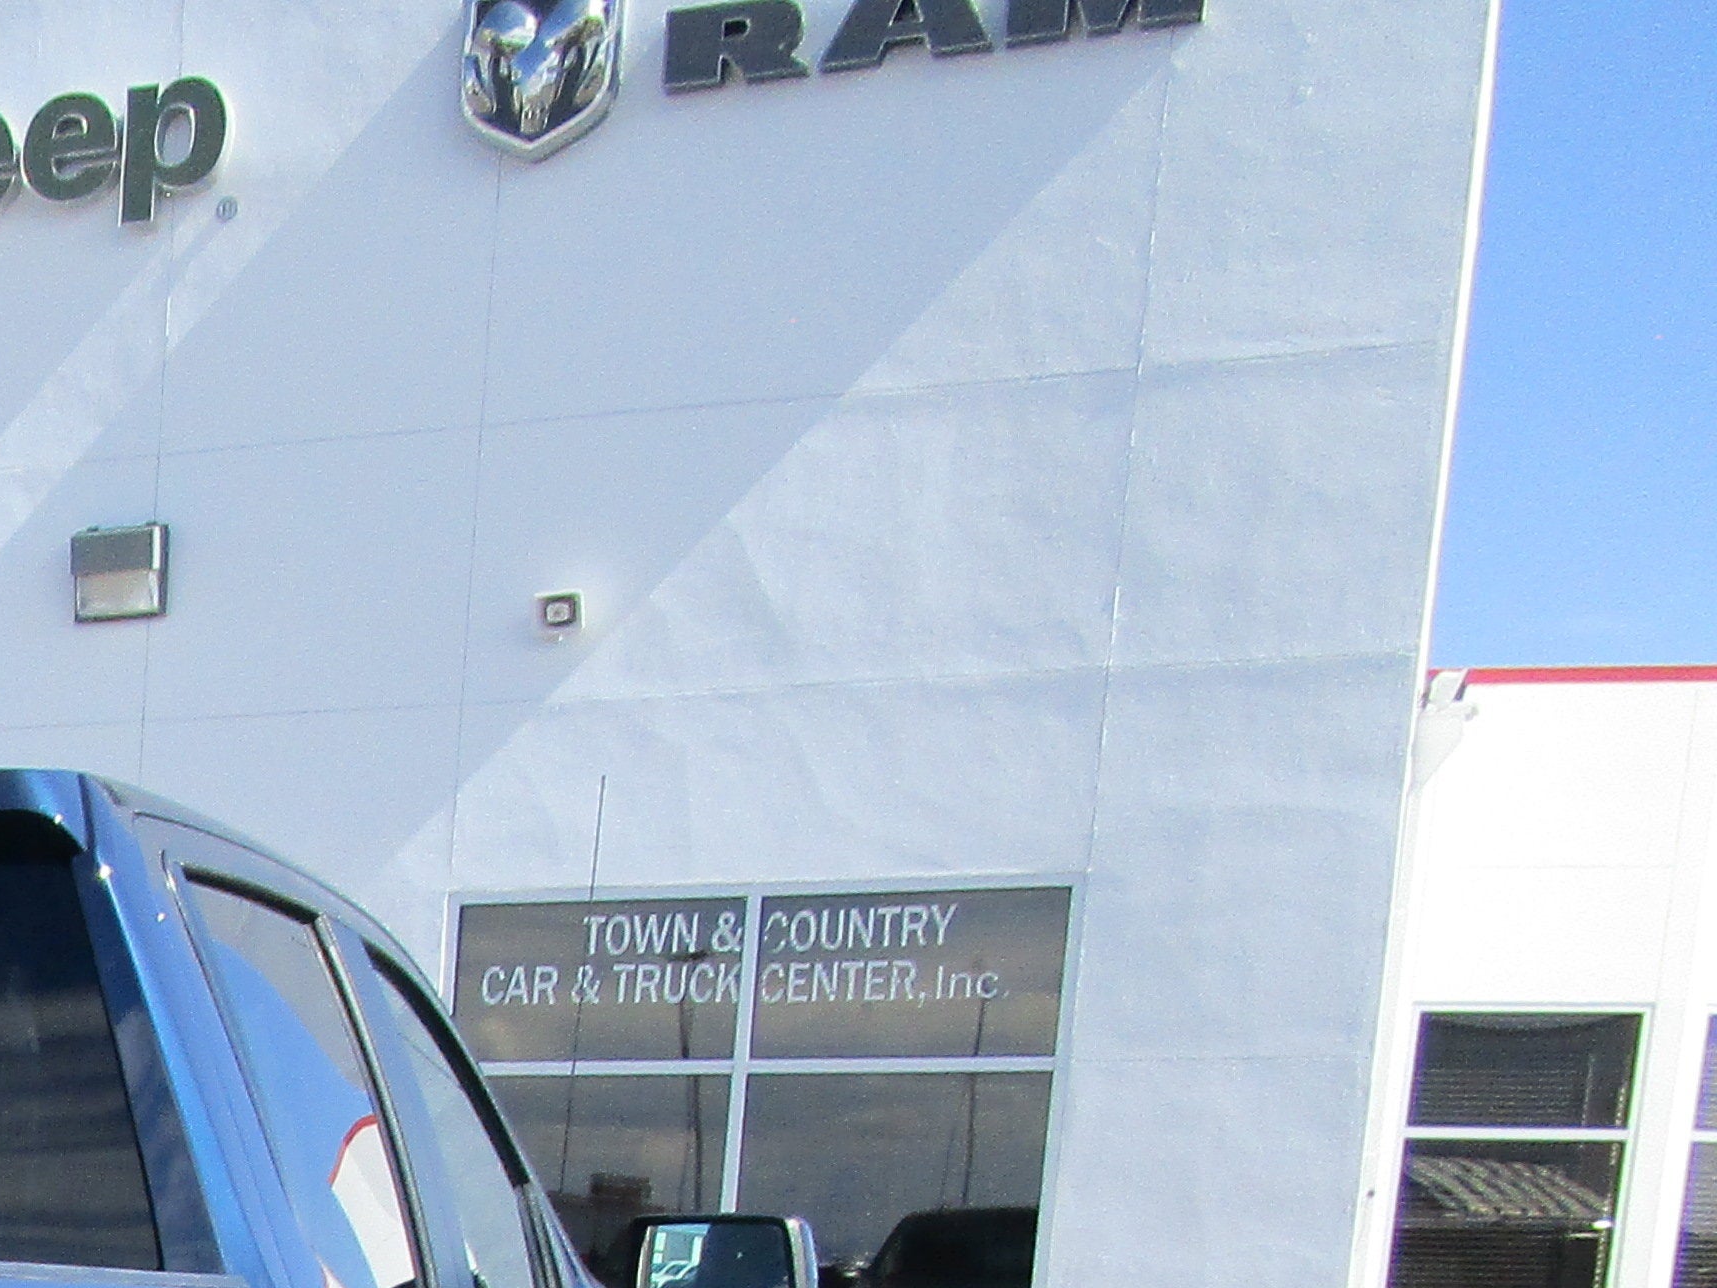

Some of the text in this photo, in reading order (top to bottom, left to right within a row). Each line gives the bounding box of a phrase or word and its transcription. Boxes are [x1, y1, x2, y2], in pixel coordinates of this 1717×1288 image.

[583, 903, 958, 957] TOWN & COUNTRY
[482, 964, 559, 1005] CAR
[571, 963, 601, 1005] &
[613, 962, 741, 1004] TRUCK
